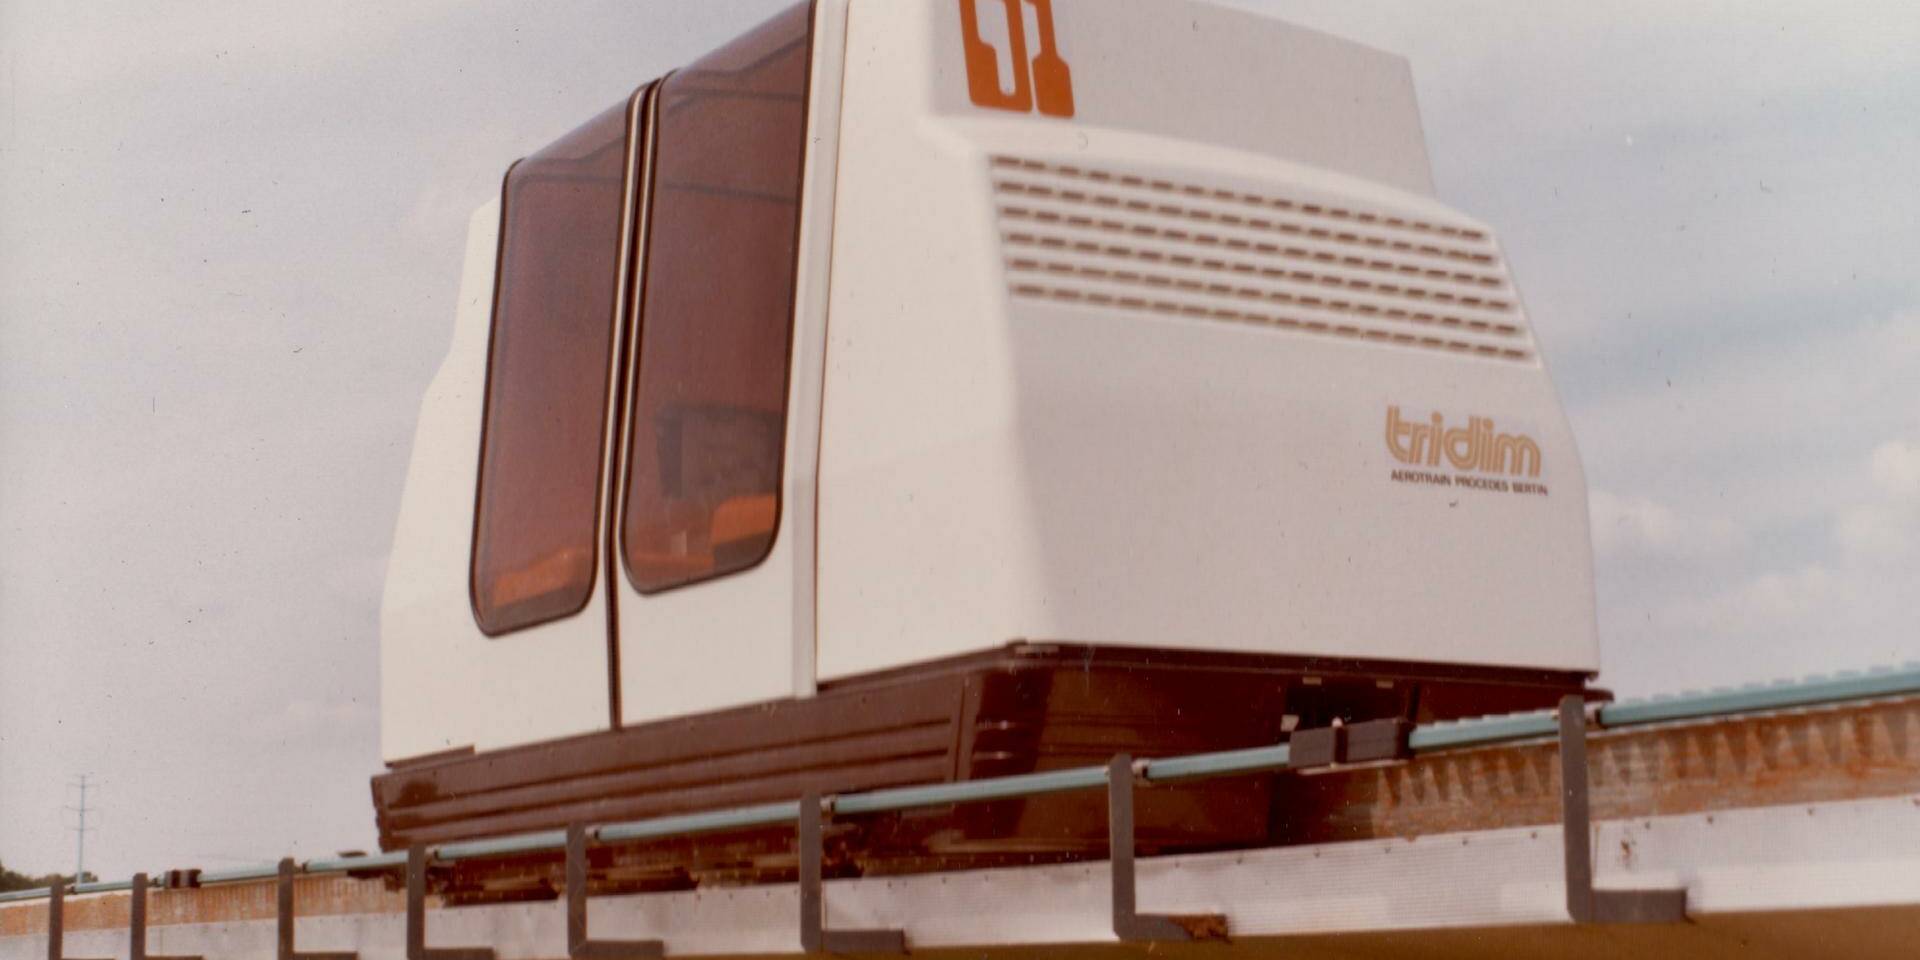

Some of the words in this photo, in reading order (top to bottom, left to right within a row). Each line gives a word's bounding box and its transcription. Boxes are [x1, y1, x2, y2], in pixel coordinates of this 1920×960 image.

[1386, 406, 1541, 477] tridim
[1391, 470, 1451, 486] AEROTRAIN
[1456, 476, 1508, 492] PROCEDES
[1513, 482, 1548, 496] BERTIN
